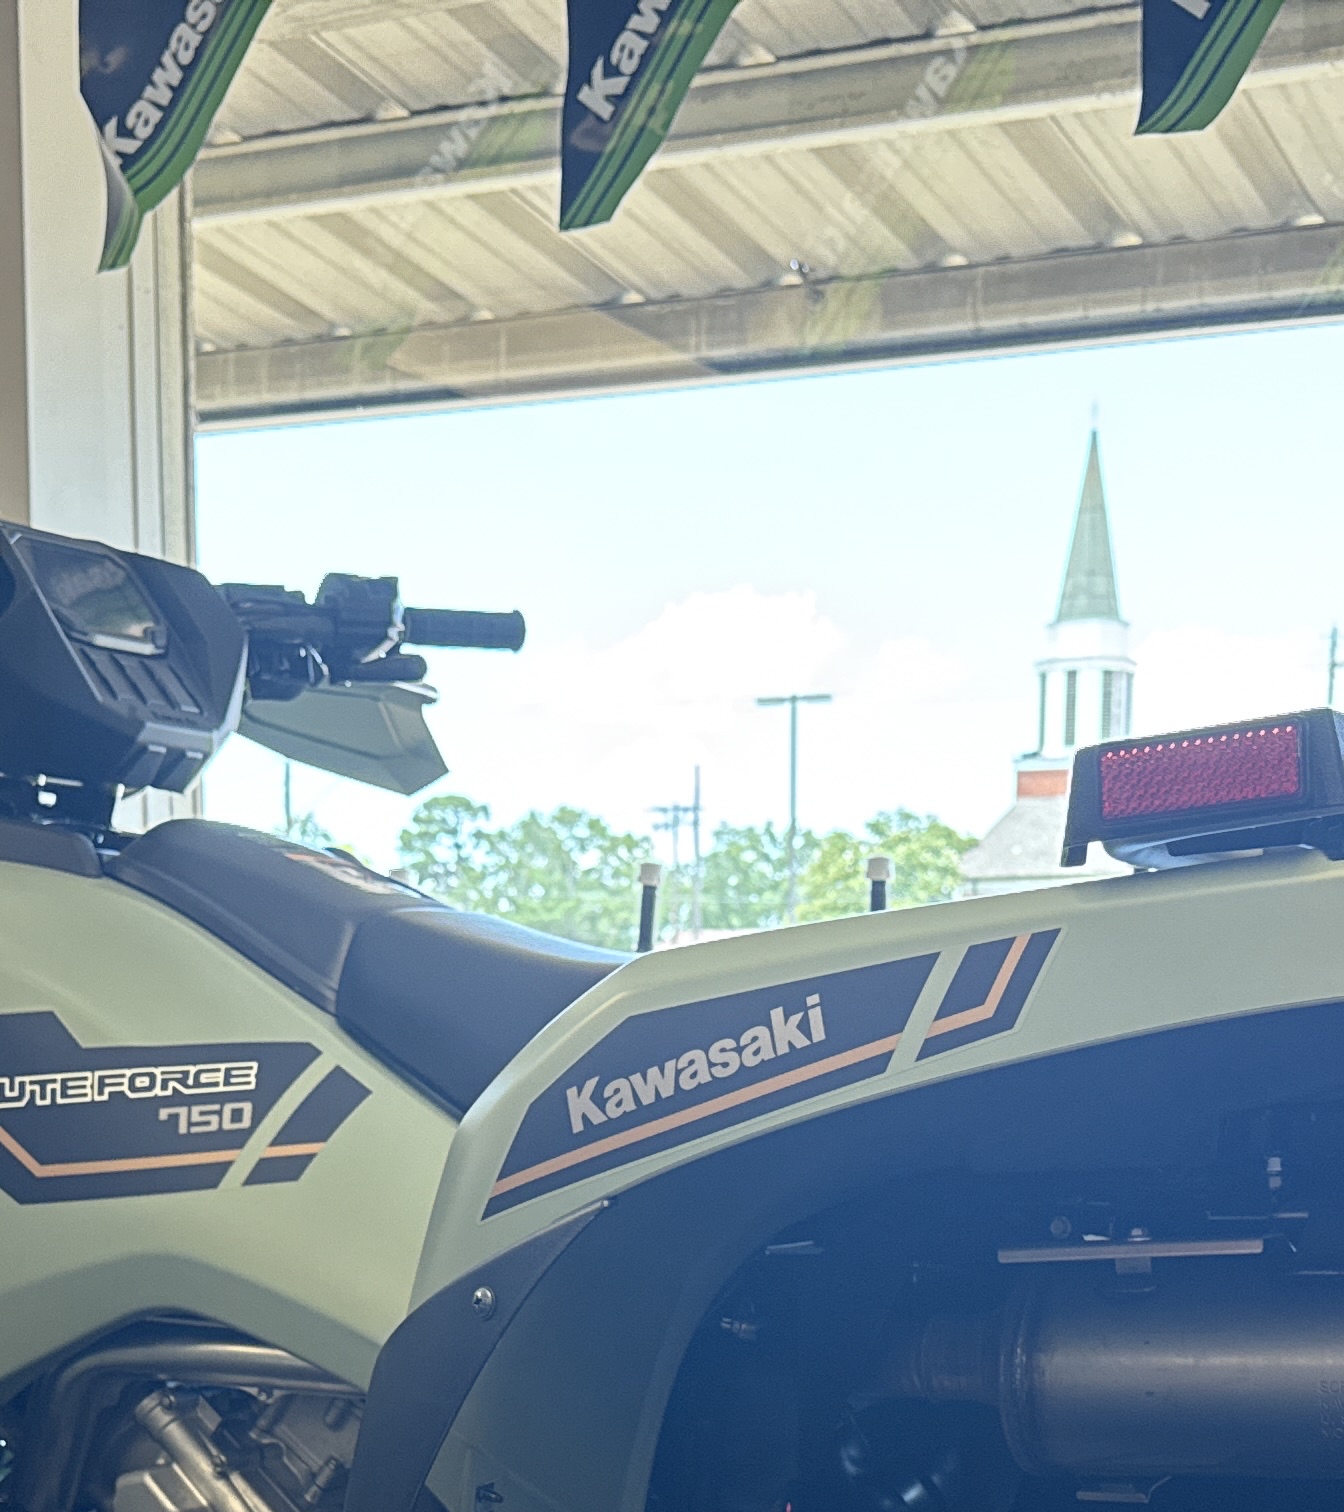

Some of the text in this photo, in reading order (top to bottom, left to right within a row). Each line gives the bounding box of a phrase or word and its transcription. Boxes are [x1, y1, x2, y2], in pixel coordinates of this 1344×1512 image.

[102, 0, 224, 165] Kawas
[92, 1061, 259, 1102] FORCE
[566, 993, 826, 1134] Kawasaki
[158, 1101, 253, 1135] 750
